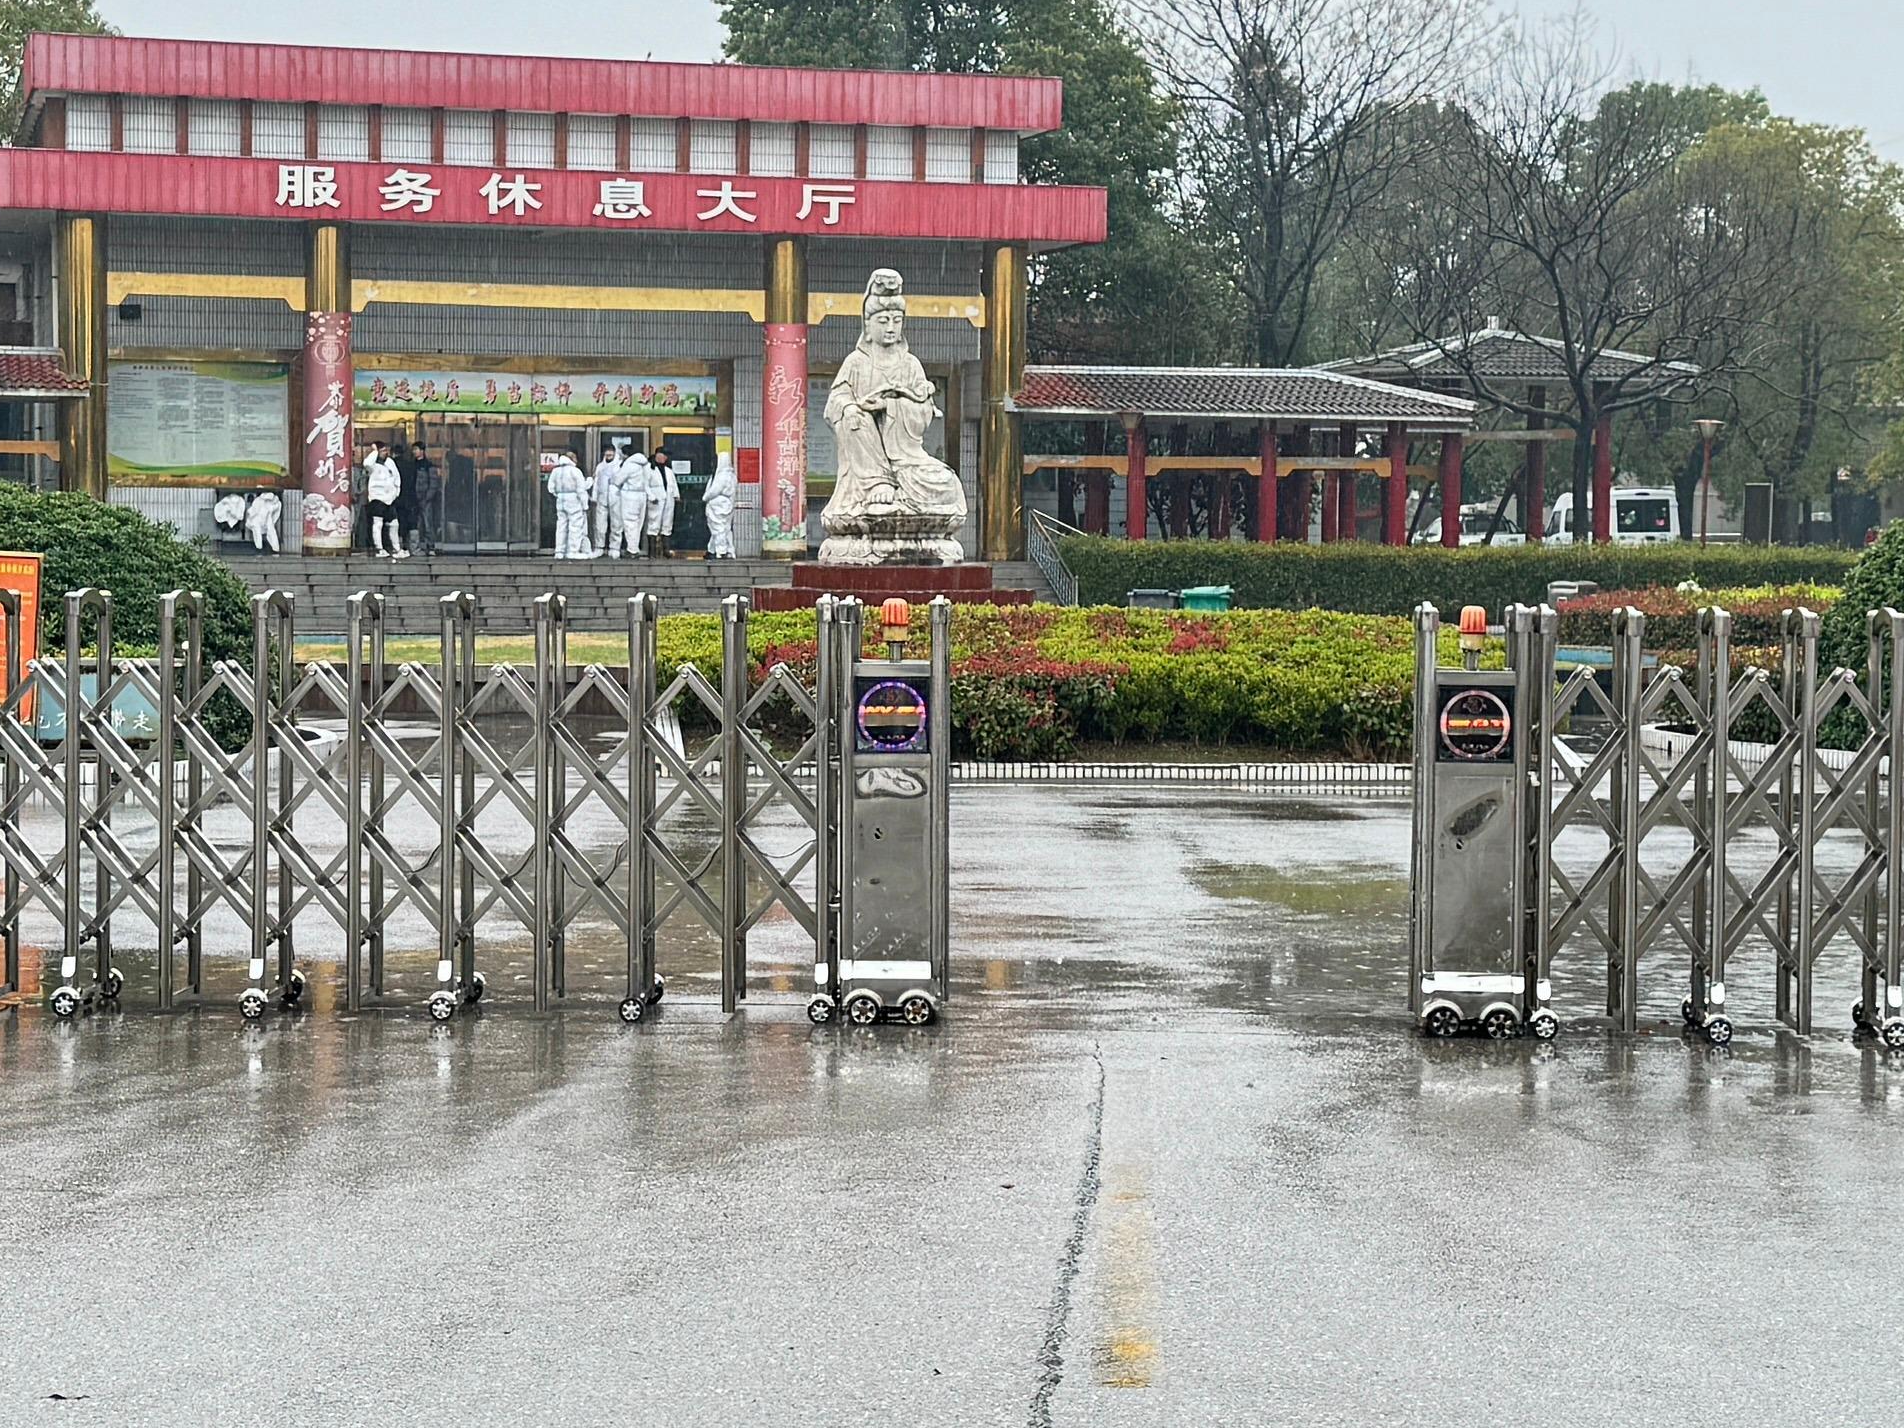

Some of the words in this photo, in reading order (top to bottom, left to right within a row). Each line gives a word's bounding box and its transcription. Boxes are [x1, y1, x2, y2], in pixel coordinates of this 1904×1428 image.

[274, 165, 857, 227] 服务休息大厅
